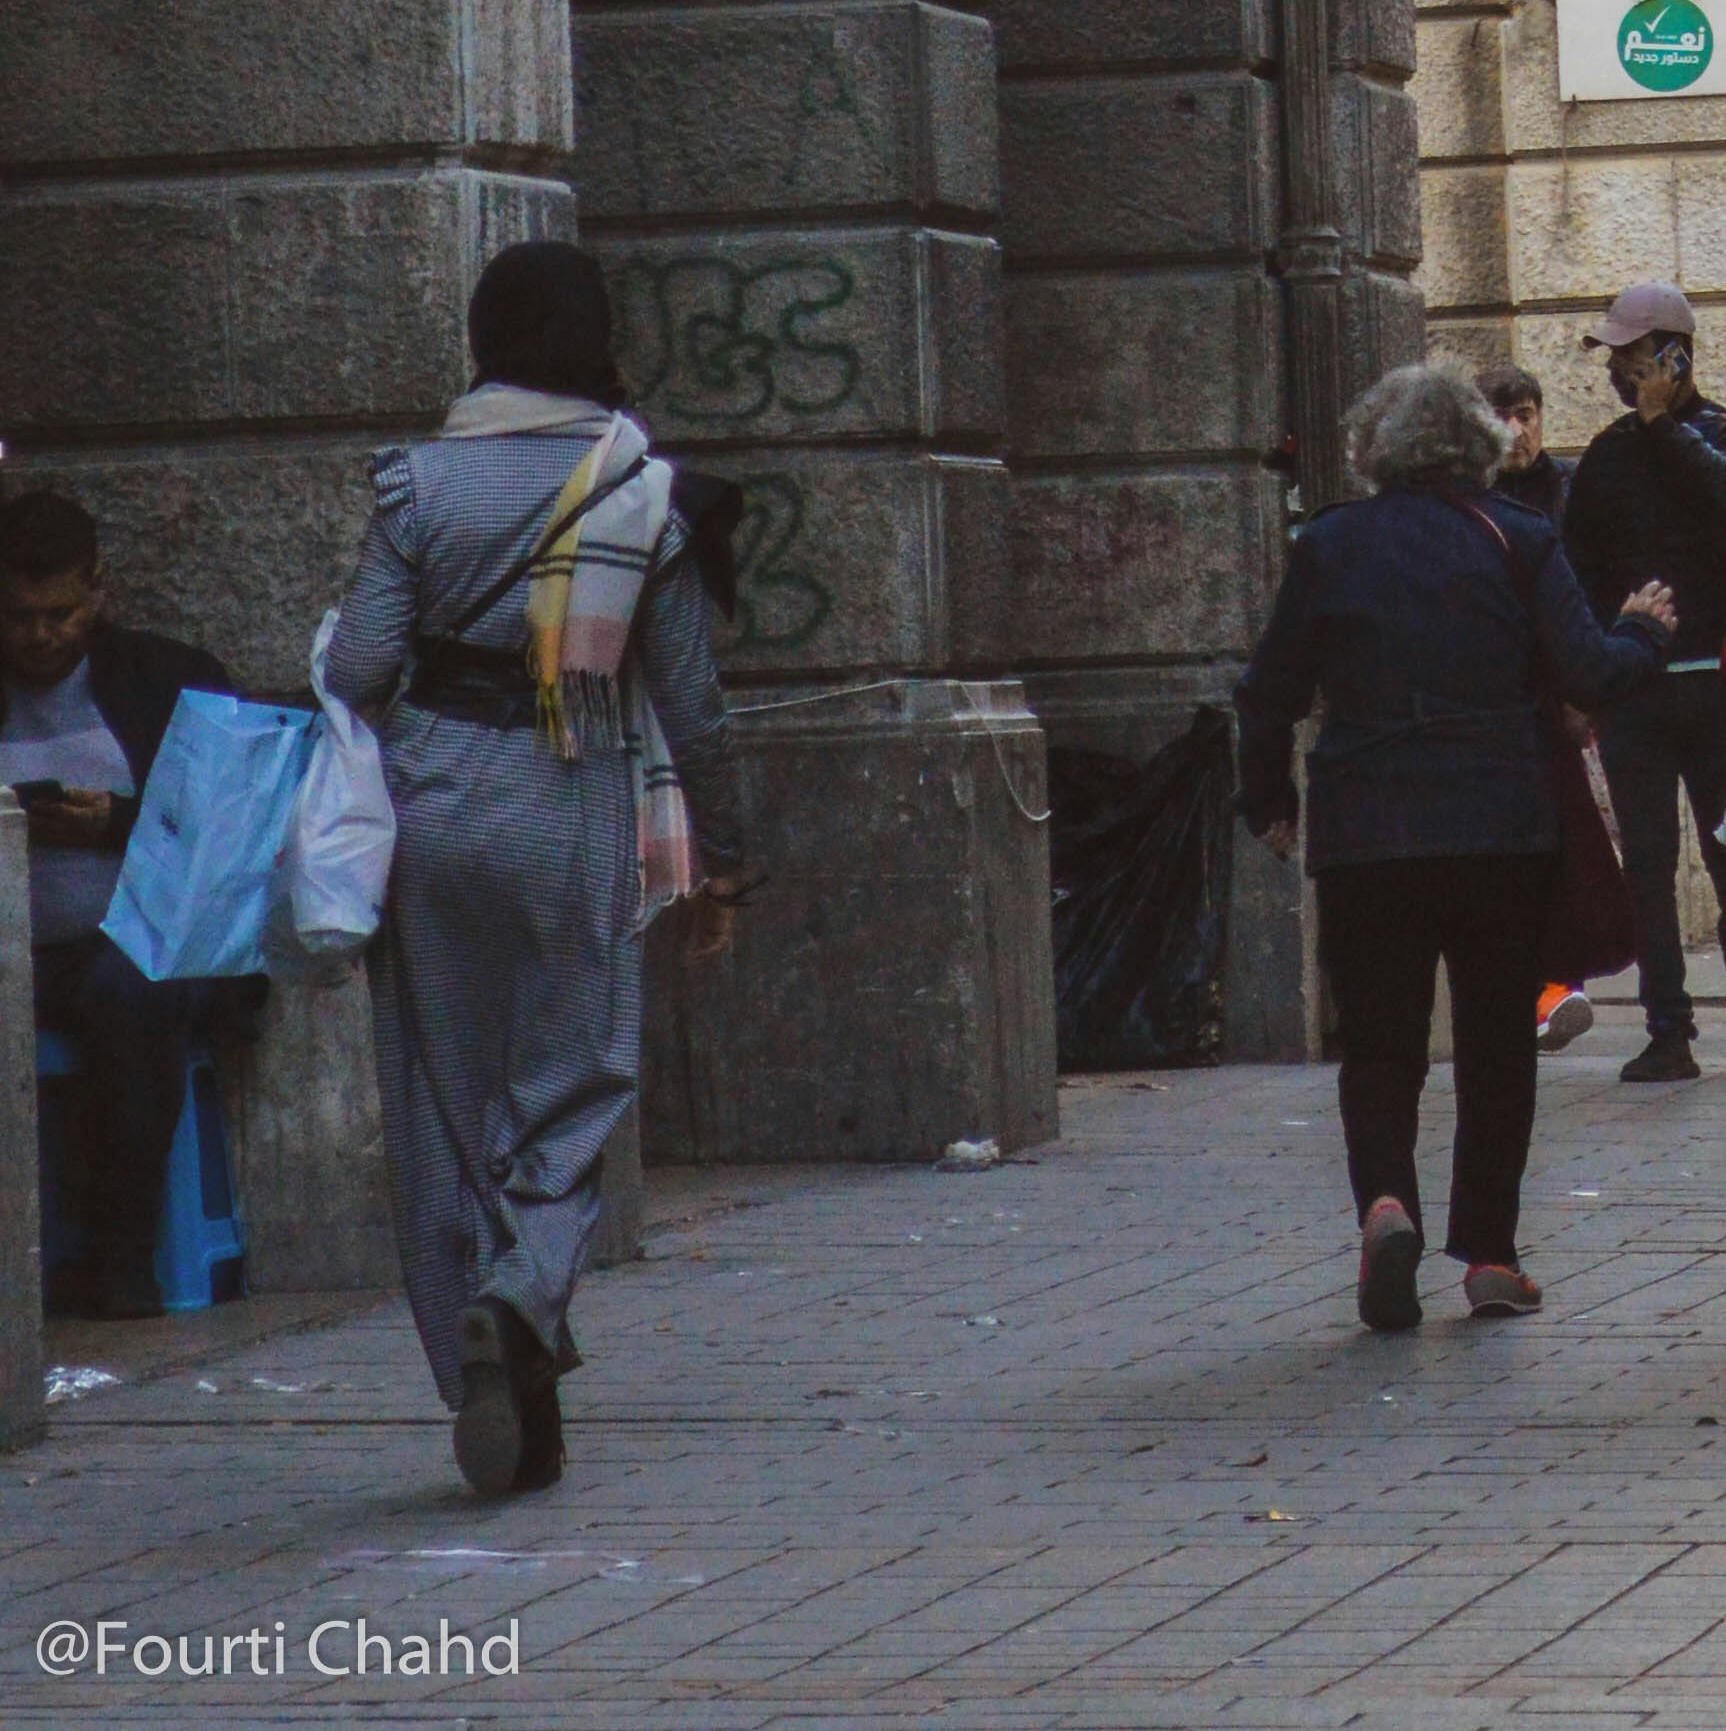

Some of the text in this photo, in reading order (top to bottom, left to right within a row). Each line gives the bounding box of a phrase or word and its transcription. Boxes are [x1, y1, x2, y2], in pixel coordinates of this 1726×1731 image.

[1624, 26, 1705, 61] نعم
[1632, 52, 1699, 66] دستور جديد
